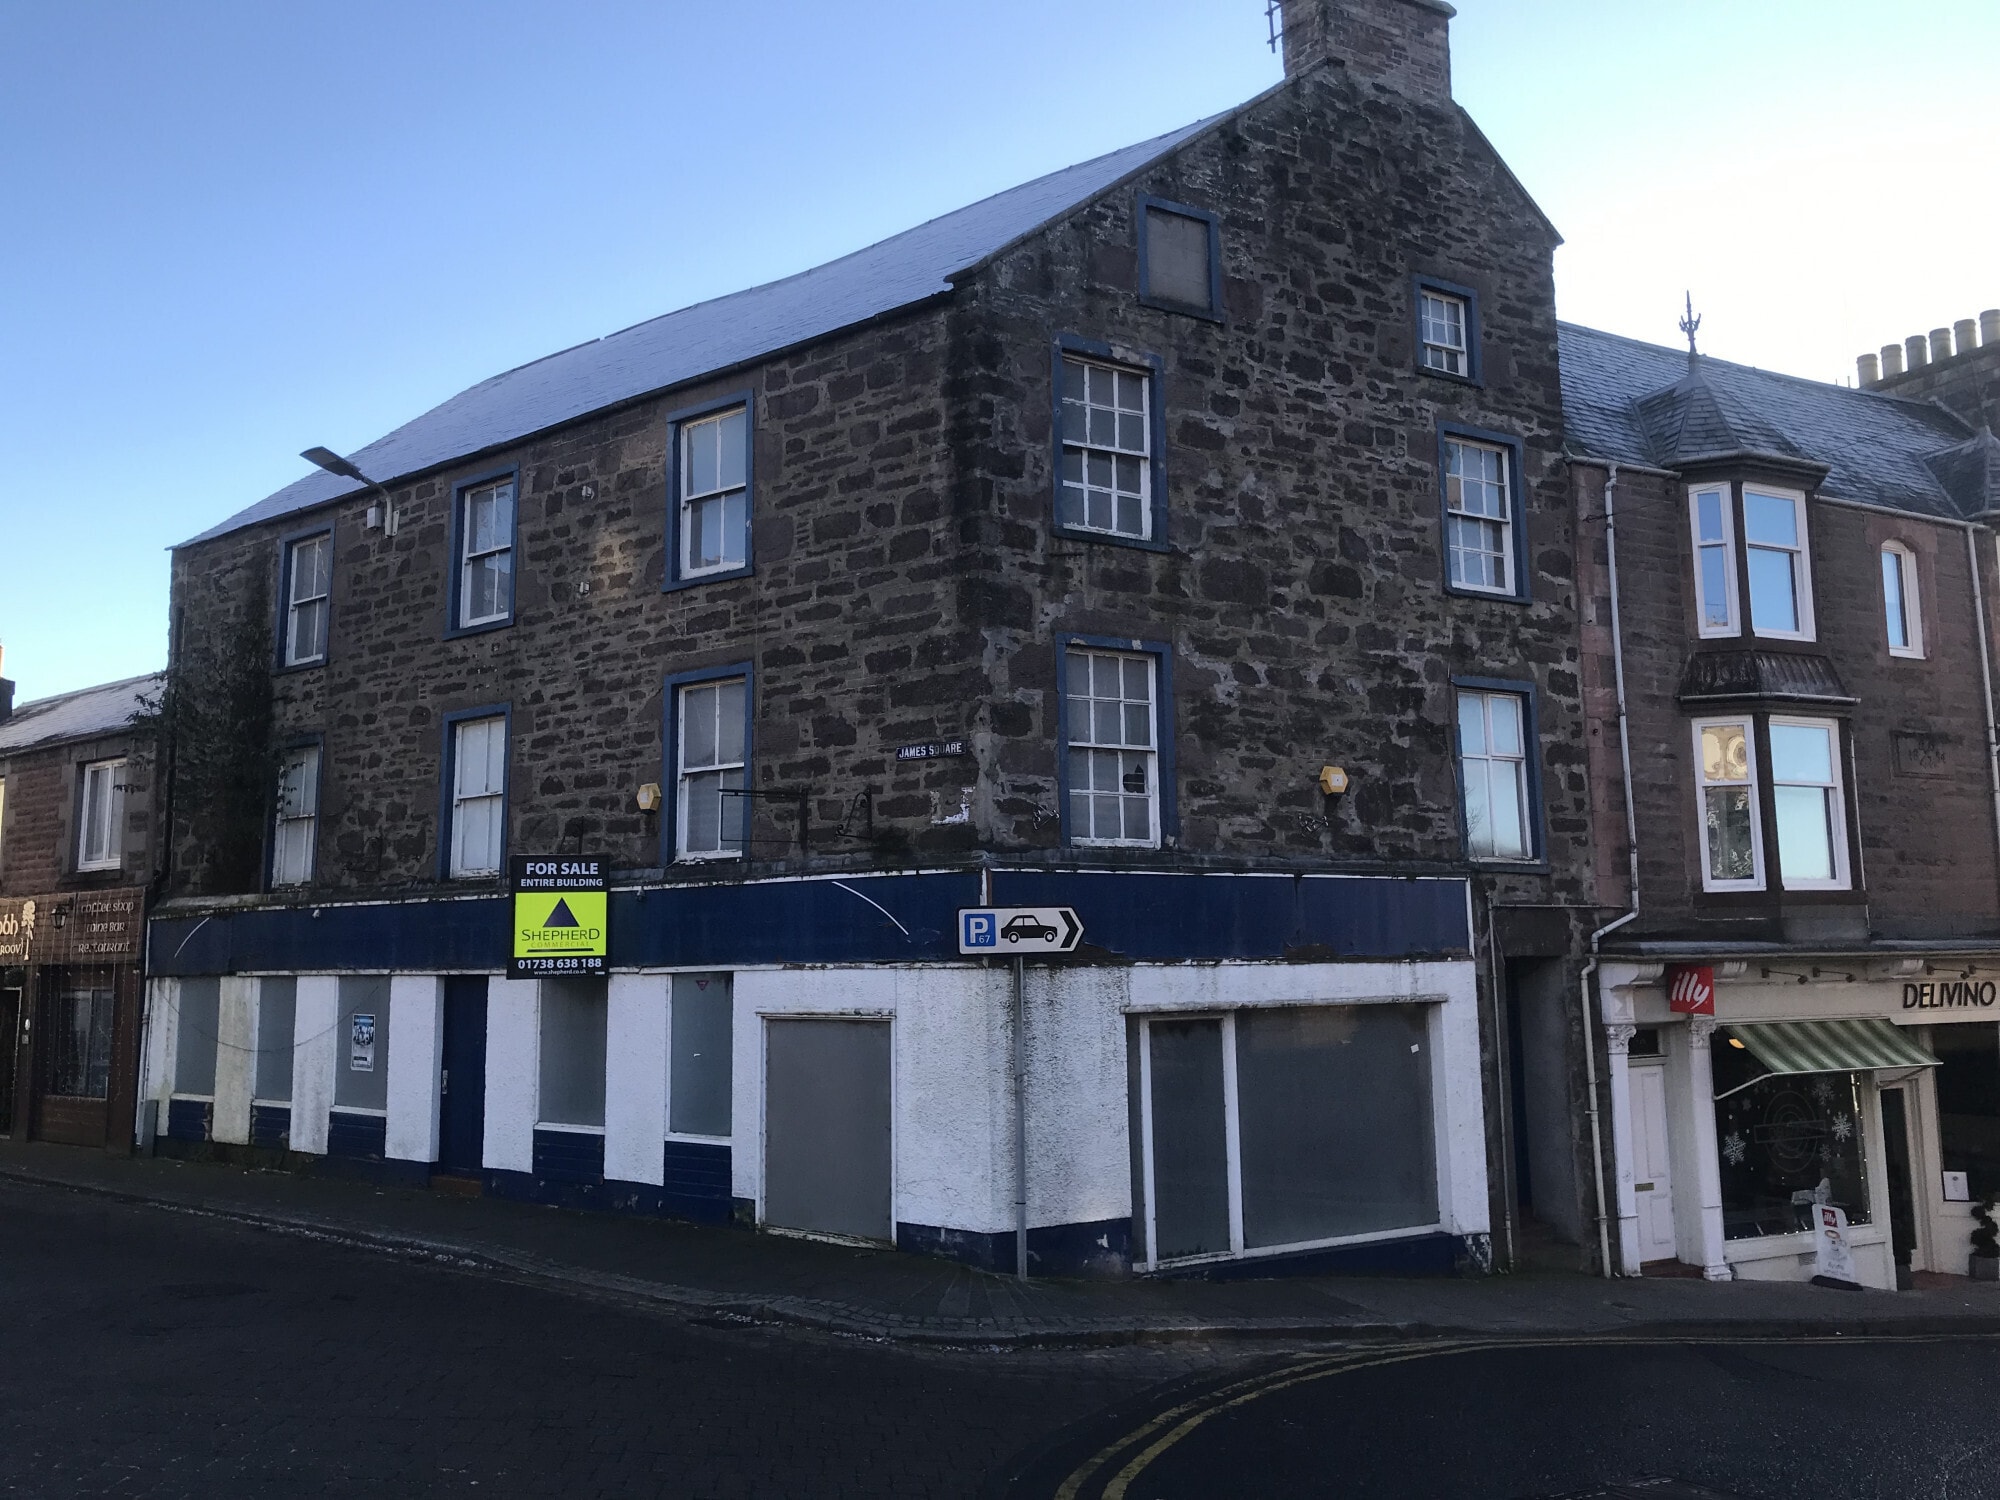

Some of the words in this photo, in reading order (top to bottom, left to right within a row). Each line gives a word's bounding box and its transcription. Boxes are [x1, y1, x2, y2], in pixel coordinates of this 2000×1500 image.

[899, 746, 926, 758] JAMES
[526, 862, 557, 875] FOR
[561, 862, 599, 875] SALE
[520, 879, 555, 887] ENTIRE
[557, 879, 603, 887] BUILDING
[113, 900, 134, 914] shop
[521, 928, 600, 941] SHEPHERD
[969, 917, 988, 944] P
[979, 935, 991, 944] 67
[518, 959, 554, 969] 01738
[557, 959, 578, 969] 638
[581, 958, 602, 968] 188
[1671, 971, 1710, 1010] illy
[1903, 981, 1997, 1009] DELIVINO
